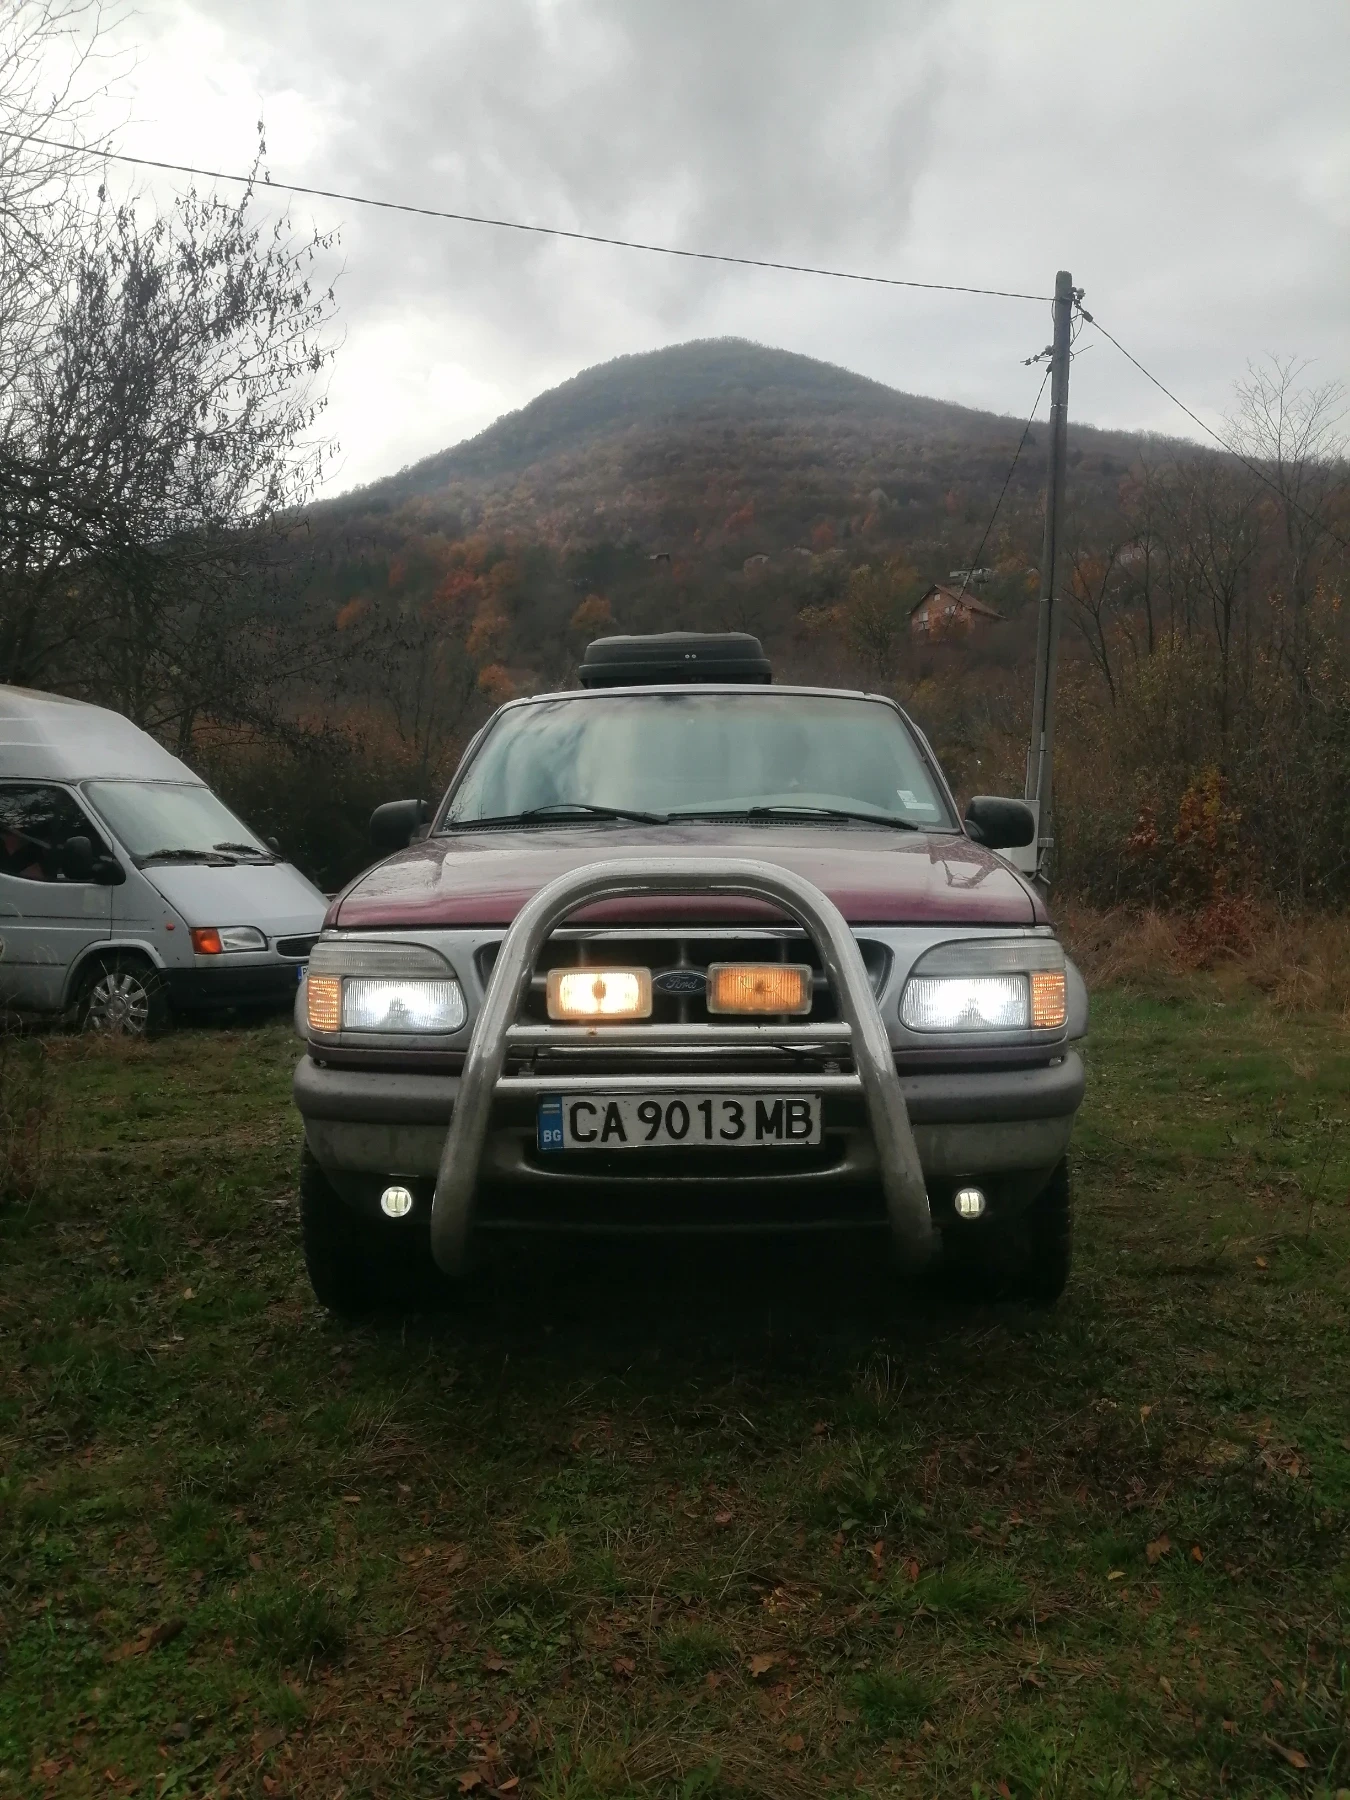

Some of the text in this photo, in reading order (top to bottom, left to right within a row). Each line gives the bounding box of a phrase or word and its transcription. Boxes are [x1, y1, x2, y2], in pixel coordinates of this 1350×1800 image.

[665, 975, 698, 989] Ford
[569, 1099, 813, 1142] CA 9013 MB
[543, 1129, 562, 1142] BG
